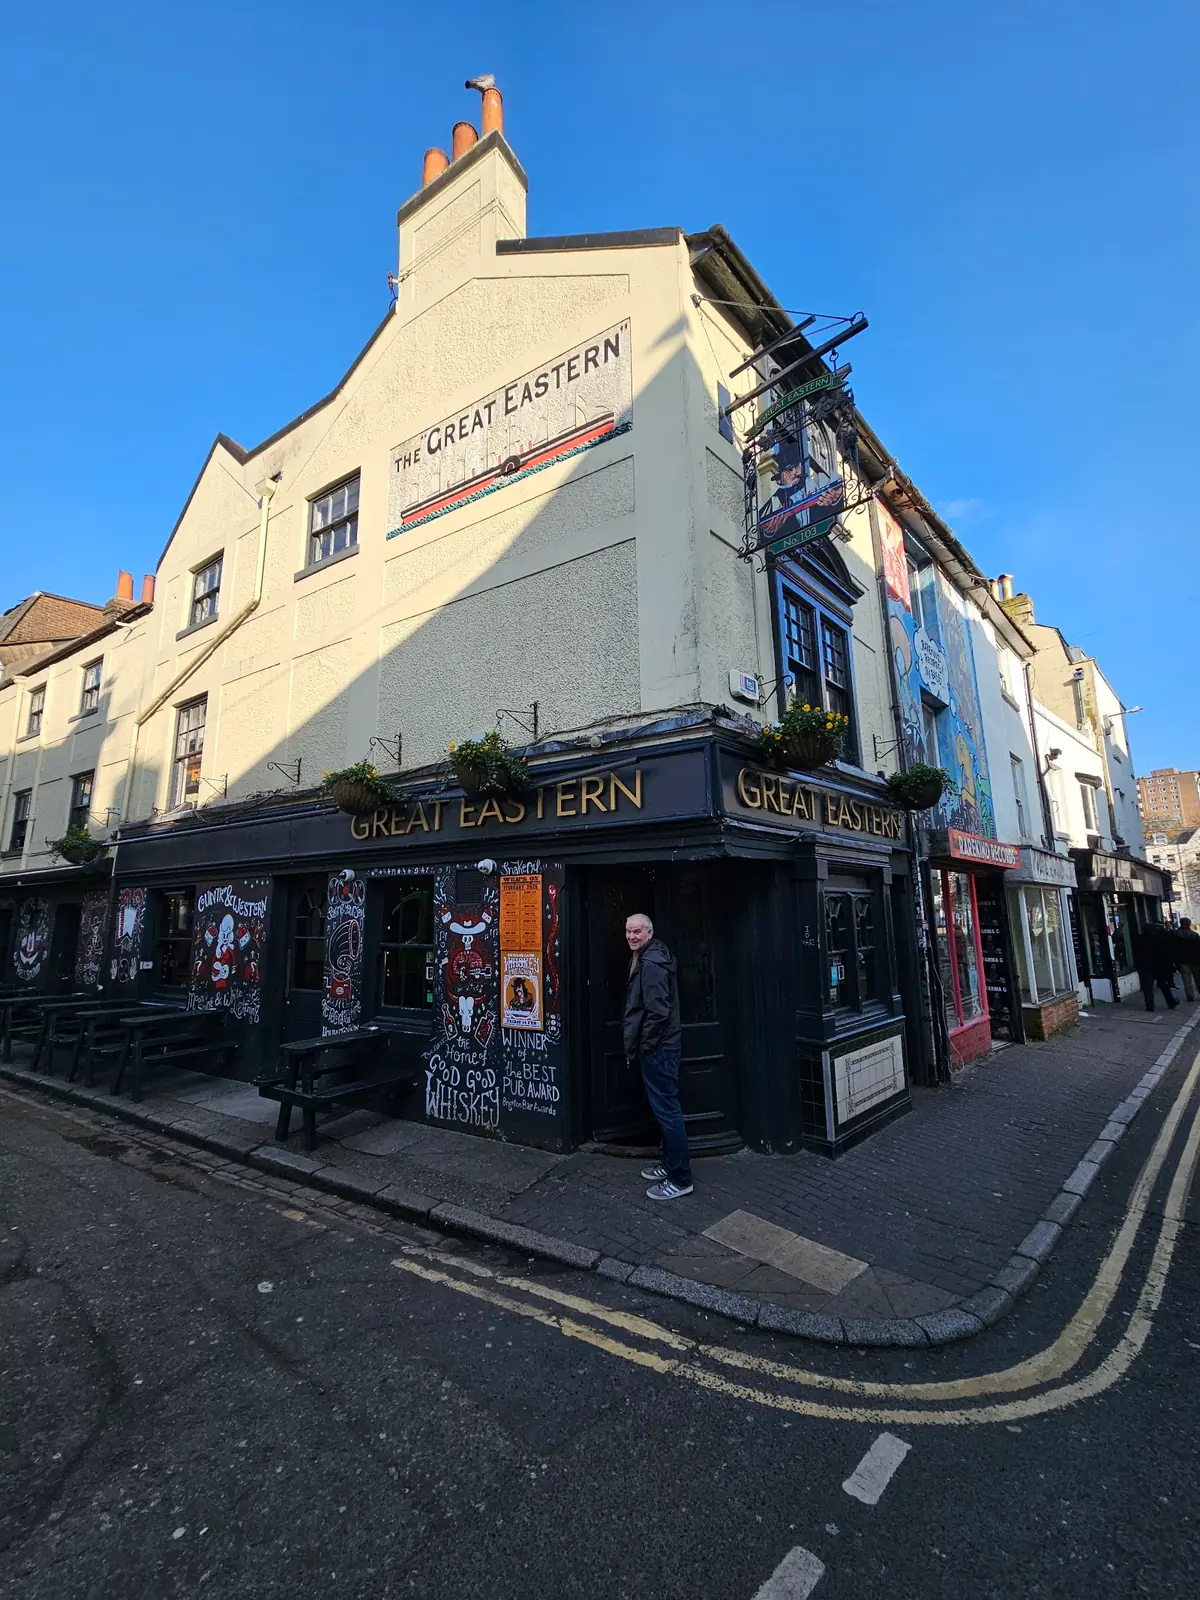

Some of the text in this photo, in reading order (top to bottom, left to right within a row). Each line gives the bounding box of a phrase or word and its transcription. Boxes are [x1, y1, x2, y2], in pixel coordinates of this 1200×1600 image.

[758, 376, 830, 424] GREAT EASTERN
[395, 448, 421, 472] THE
[800, 526, 817, 544] 103
[351, 769, 642, 840] GREAT EASTERN
[737, 767, 901, 840] GREAT EASTERN
[232, 895, 268, 918] WESTERN
[501, 1028, 547, 1050] WINNER
[446, 1044, 479, 1065] Home
[478, 1050, 488, 1067] of
[517, 1049, 527, 1062] of
[505, 1060, 557, 1082] the BEST
[424, 1070, 500, 1127] WHISKEY
[502, 1076, 560, 1102] PUB AWARD
[522, 1100, 533, 1111] Bar
[533, 1103, 557, 1116] Awards
